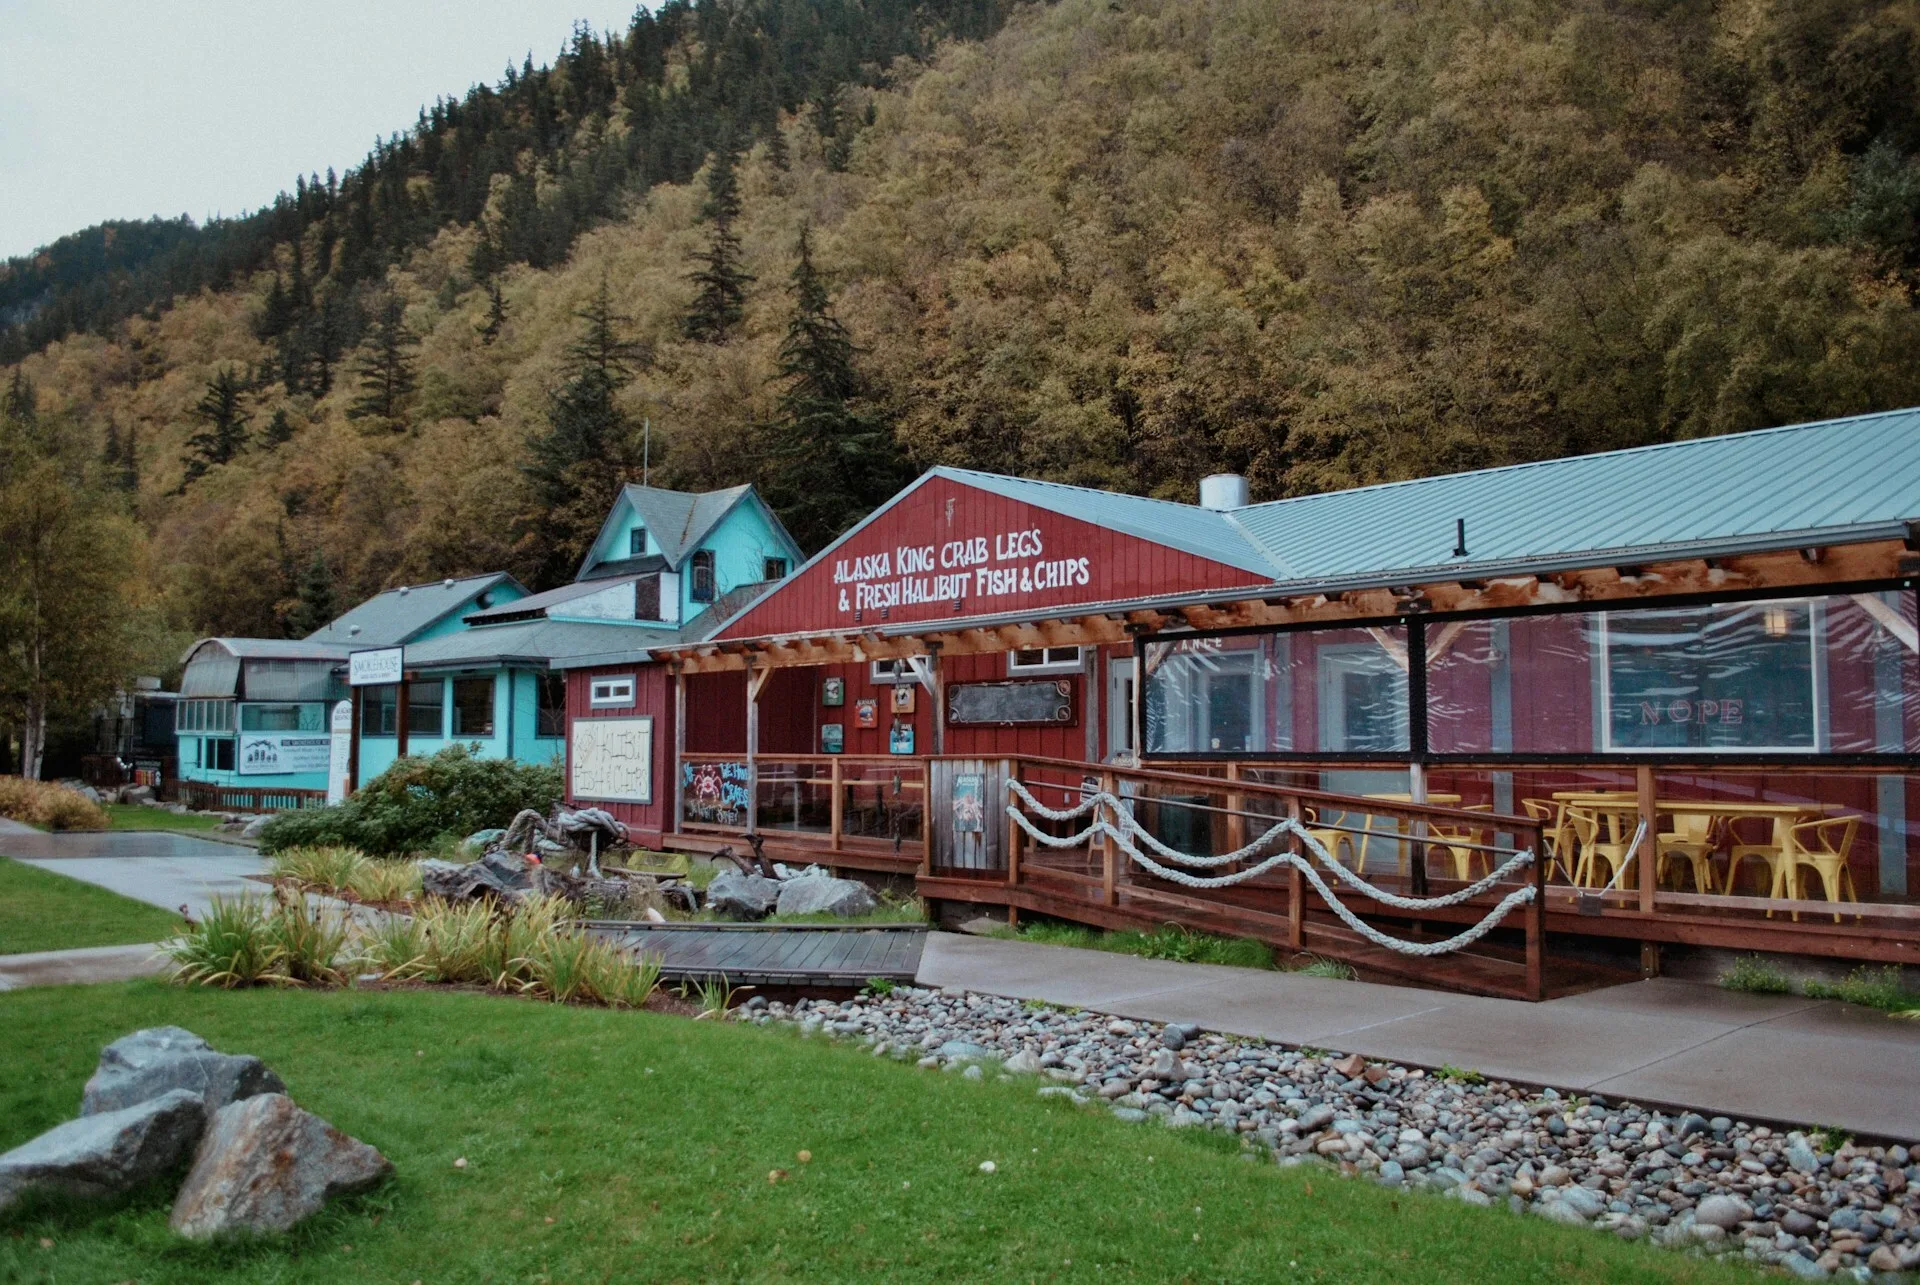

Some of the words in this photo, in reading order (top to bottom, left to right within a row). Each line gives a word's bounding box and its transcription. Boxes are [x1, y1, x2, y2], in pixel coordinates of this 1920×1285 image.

[833, 552, 890, 584] ALASKA
[896, 546, 934, 575] KING
[940, 537, 989, 568] CRAB
[995, 528, 1043, 561] LEGS
[838, 589, 850, 612] &
[855, 577, 900, 610] FRESH
[902, 572, 971, 605] HALIBUT
[976, 567, 1017, 597] FISH
[1020, 567, 1033, 592] &
[1034, 557, 1090, 591] CHIPS
[354, 656, 398, 674] SMOKEHOUSE
[1640, 699, 1743, 725] NOPE
